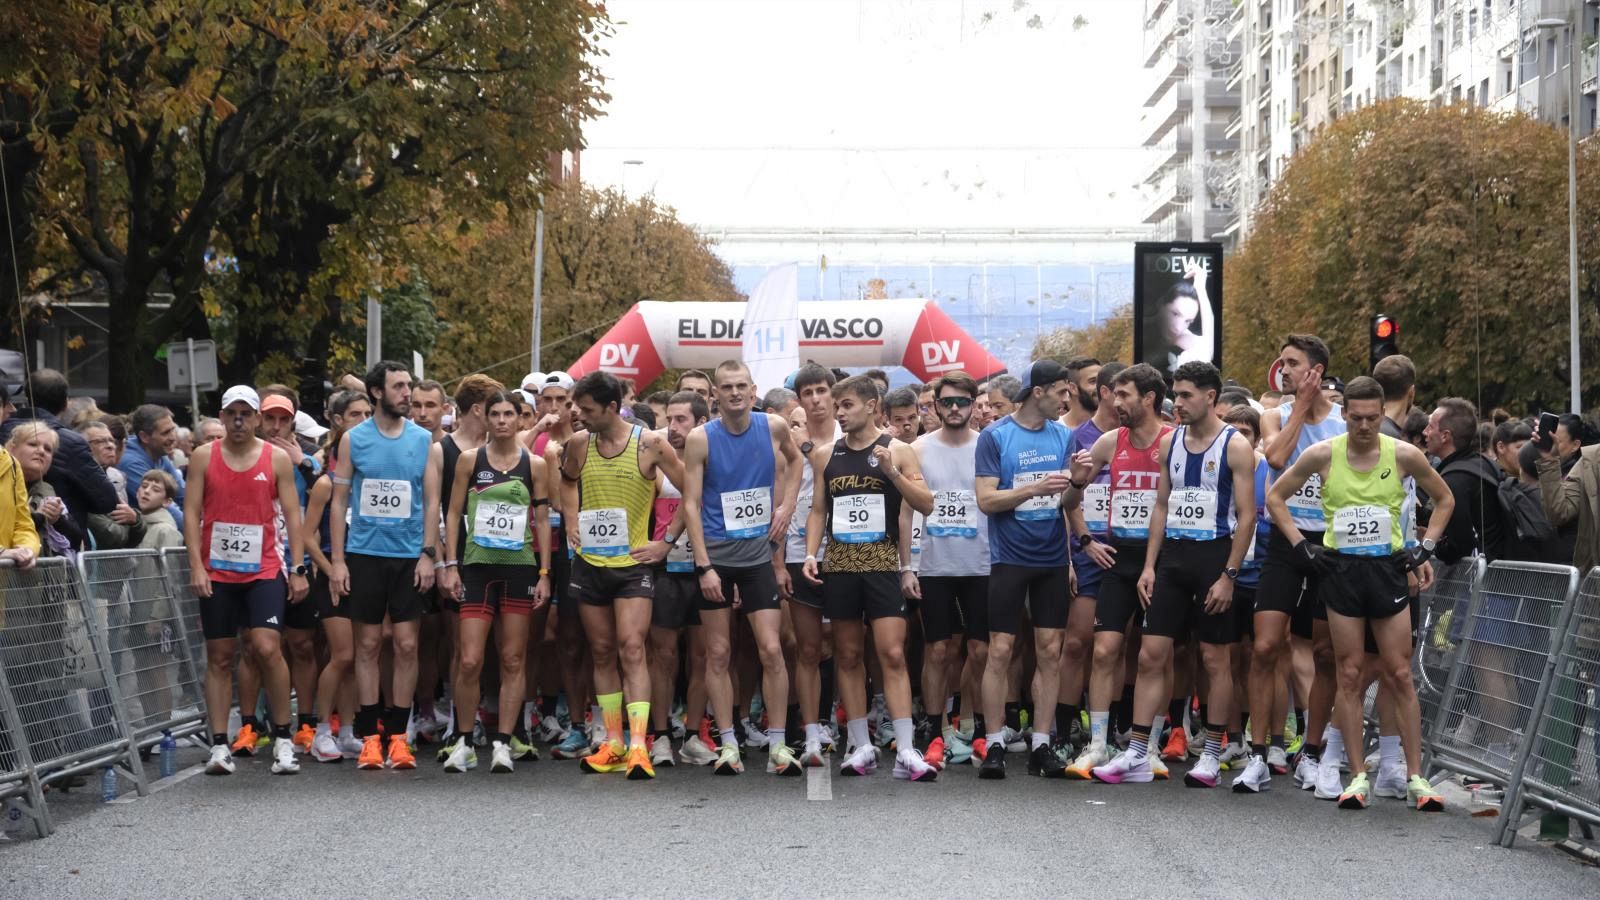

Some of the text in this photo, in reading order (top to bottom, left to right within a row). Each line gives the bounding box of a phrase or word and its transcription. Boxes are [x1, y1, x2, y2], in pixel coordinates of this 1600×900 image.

[678, 318, 883, 338] EL DIA VASCO
[600, 343, 640, 367] DV
[921, 340, 960, 366] DV
[1018, 449, 1037, 460] SALTO
[1019, 454, 1058, 466] FOUNDATION
[1116, 471, 1160, 489] ZTT
[370, 495, 401, 508] 340
[734, 503, 764, 519] 206
[848, 509, 869, 523] 50
[938, 505, 966, 517] 384
[1121, 505, 1149, 518] 375
[1175, 505, 1205, 519] 409
[486, 515, 514, 531] 401
[588, 523, 618, 537] 402
[1347, 520, 1380, 537] 252
[221, 538, 250, 552] 342
